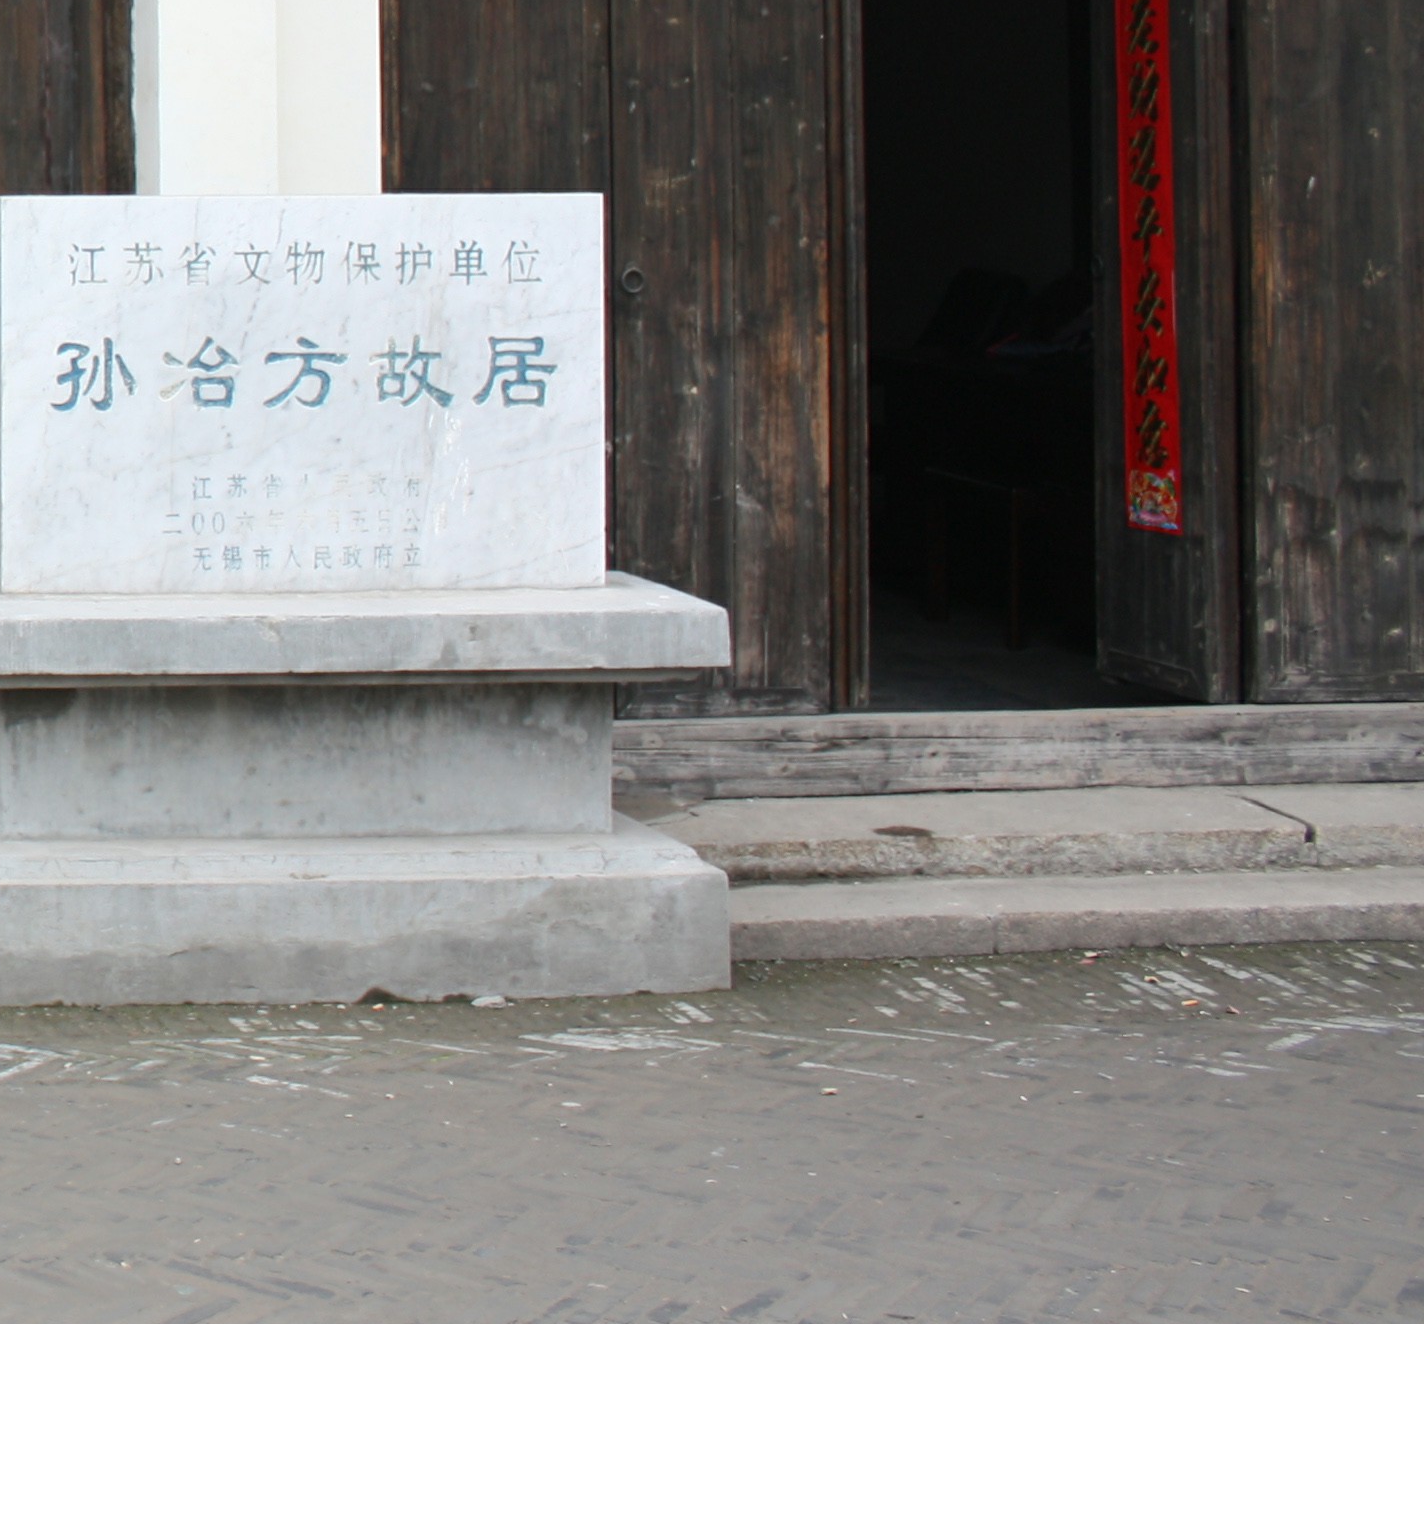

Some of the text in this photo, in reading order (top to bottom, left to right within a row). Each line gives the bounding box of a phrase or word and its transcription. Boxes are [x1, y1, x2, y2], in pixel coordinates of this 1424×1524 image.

[67, 239, 544, 287] 江苏省文物保护单位
[49, 334, 559, 413] 孙冶方故居
[190, 543, 424, 572] 无锡市人民政府立
